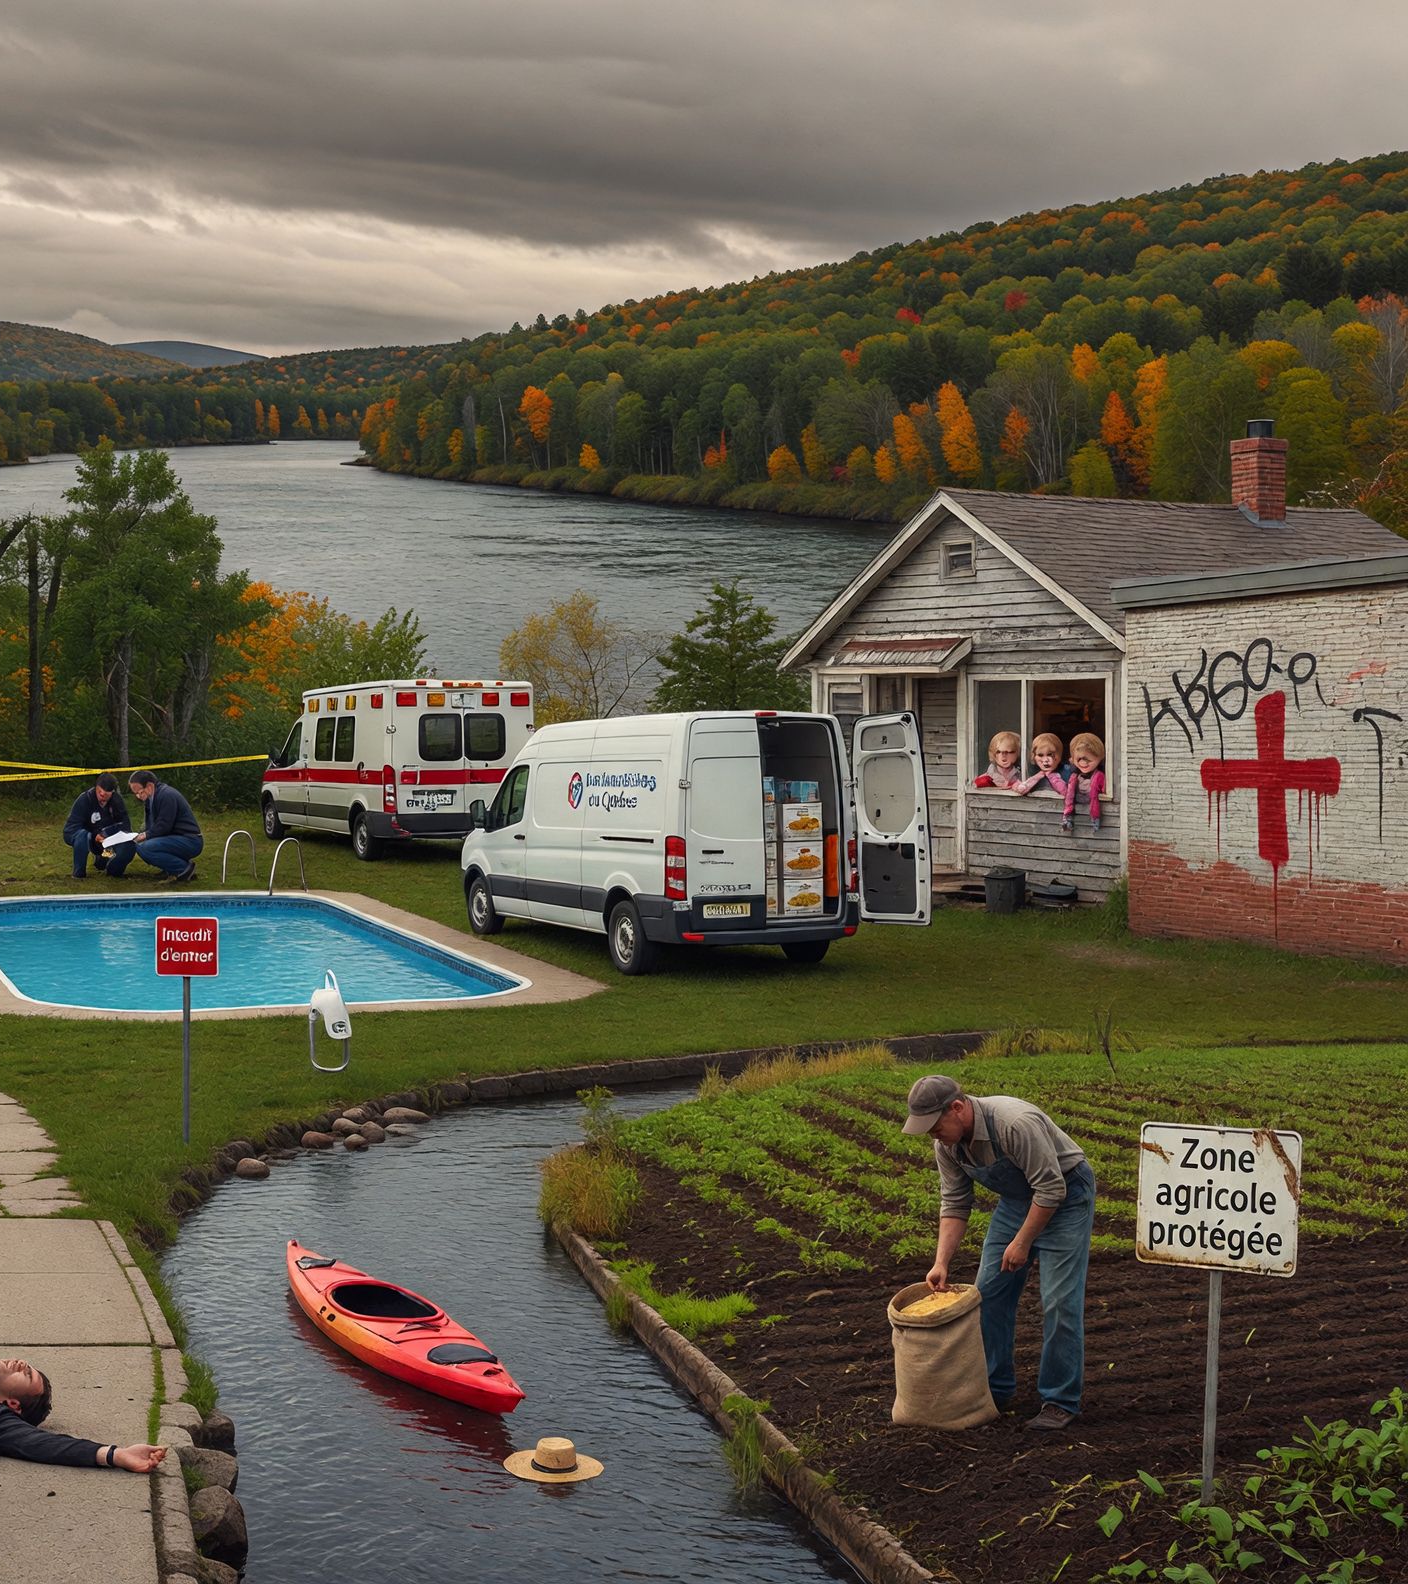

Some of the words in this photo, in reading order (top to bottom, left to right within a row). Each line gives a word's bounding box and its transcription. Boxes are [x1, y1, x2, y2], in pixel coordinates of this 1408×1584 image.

[1180, 1138, 1255, 1173] Zone
[1156, 1179, 1277, 1215] agricole
[1148, 1219, 1283, 1261] protégée
